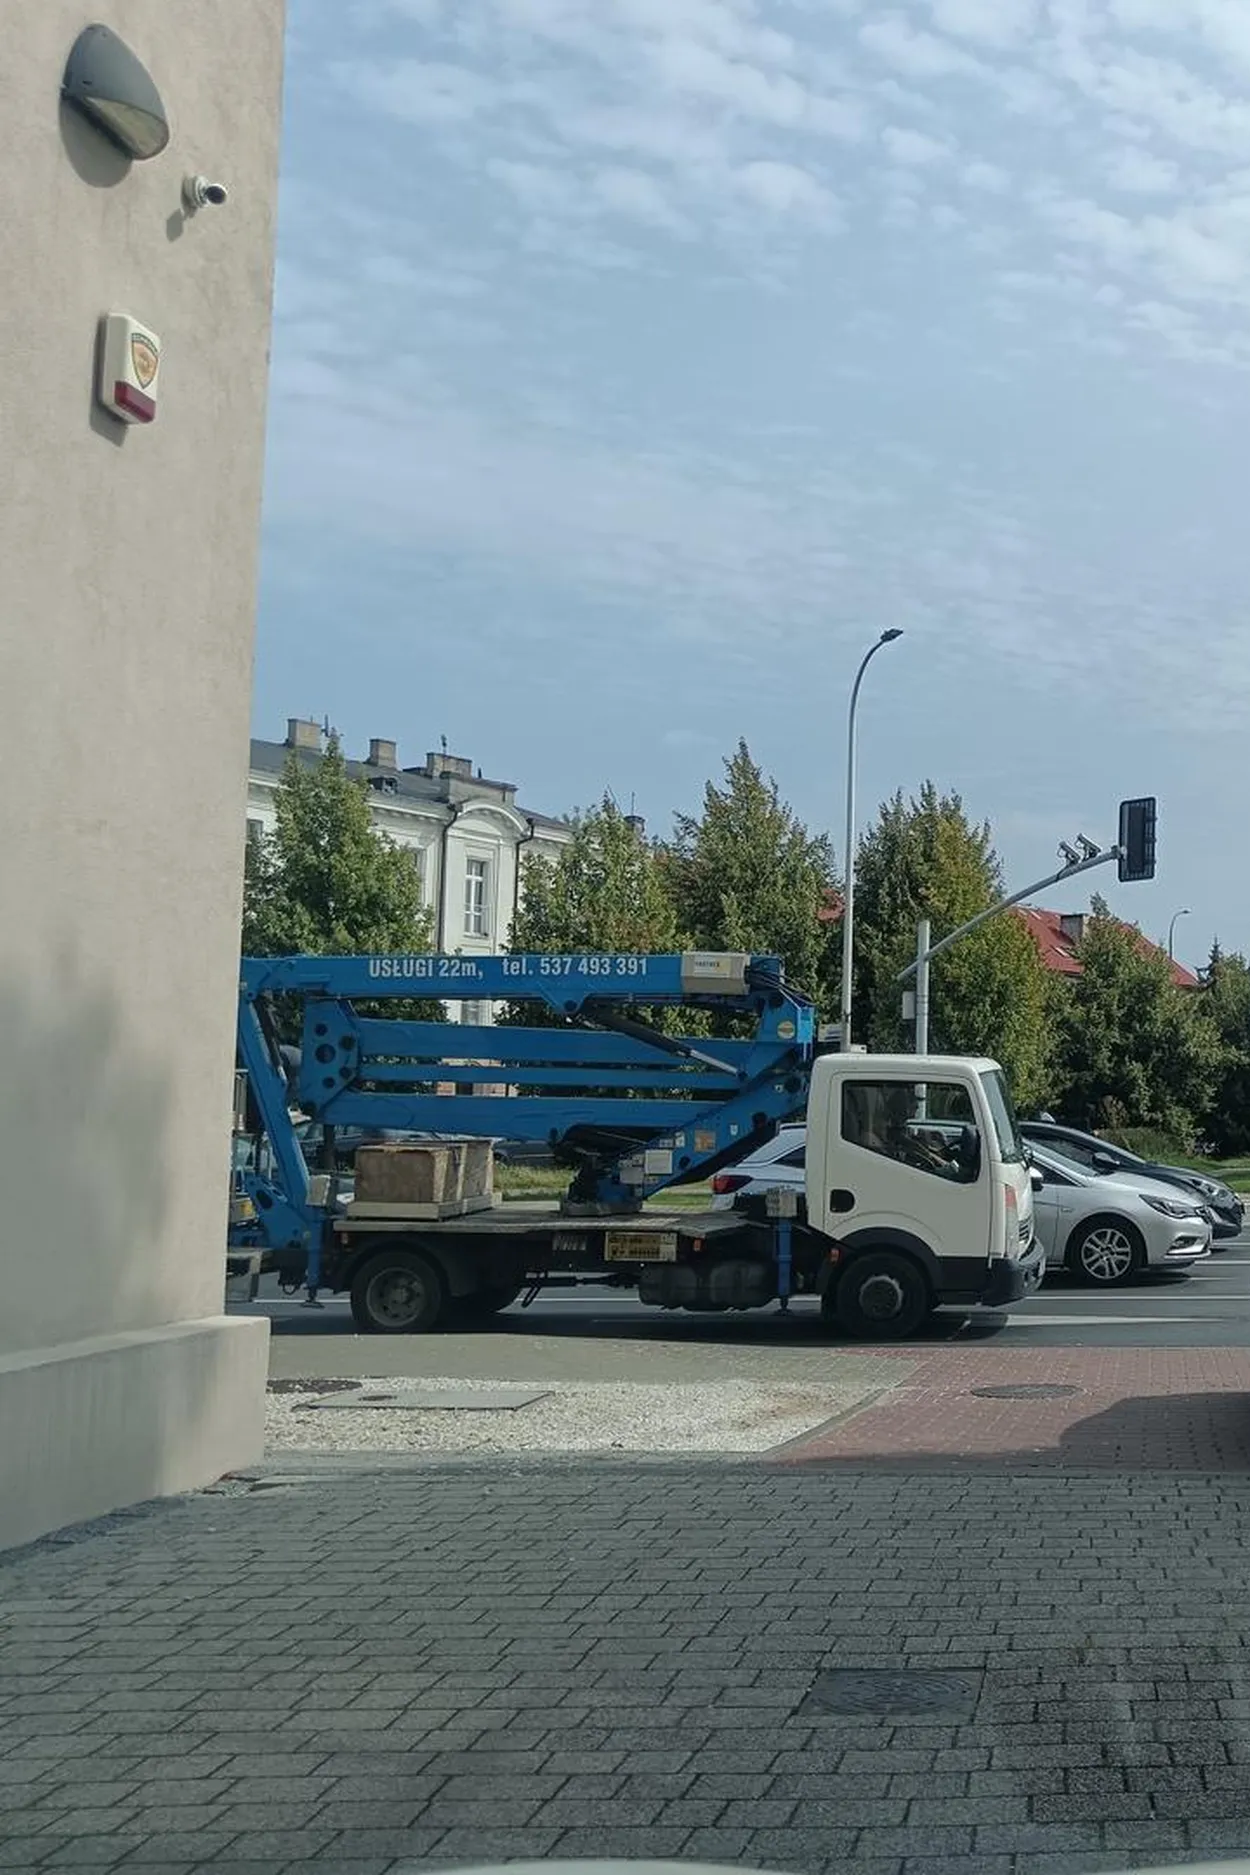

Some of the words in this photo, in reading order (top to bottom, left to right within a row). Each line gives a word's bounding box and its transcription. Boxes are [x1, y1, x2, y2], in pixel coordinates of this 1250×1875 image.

[369, 959, 434, 978] USŁUGI
[439, 959, 484, 980] 22m,
[502, 957, 534, 975] tel.
[540, 957, 573, 976] 537
[578, 957, 611, 976] 493
[616, 957, 648, 976] 391
